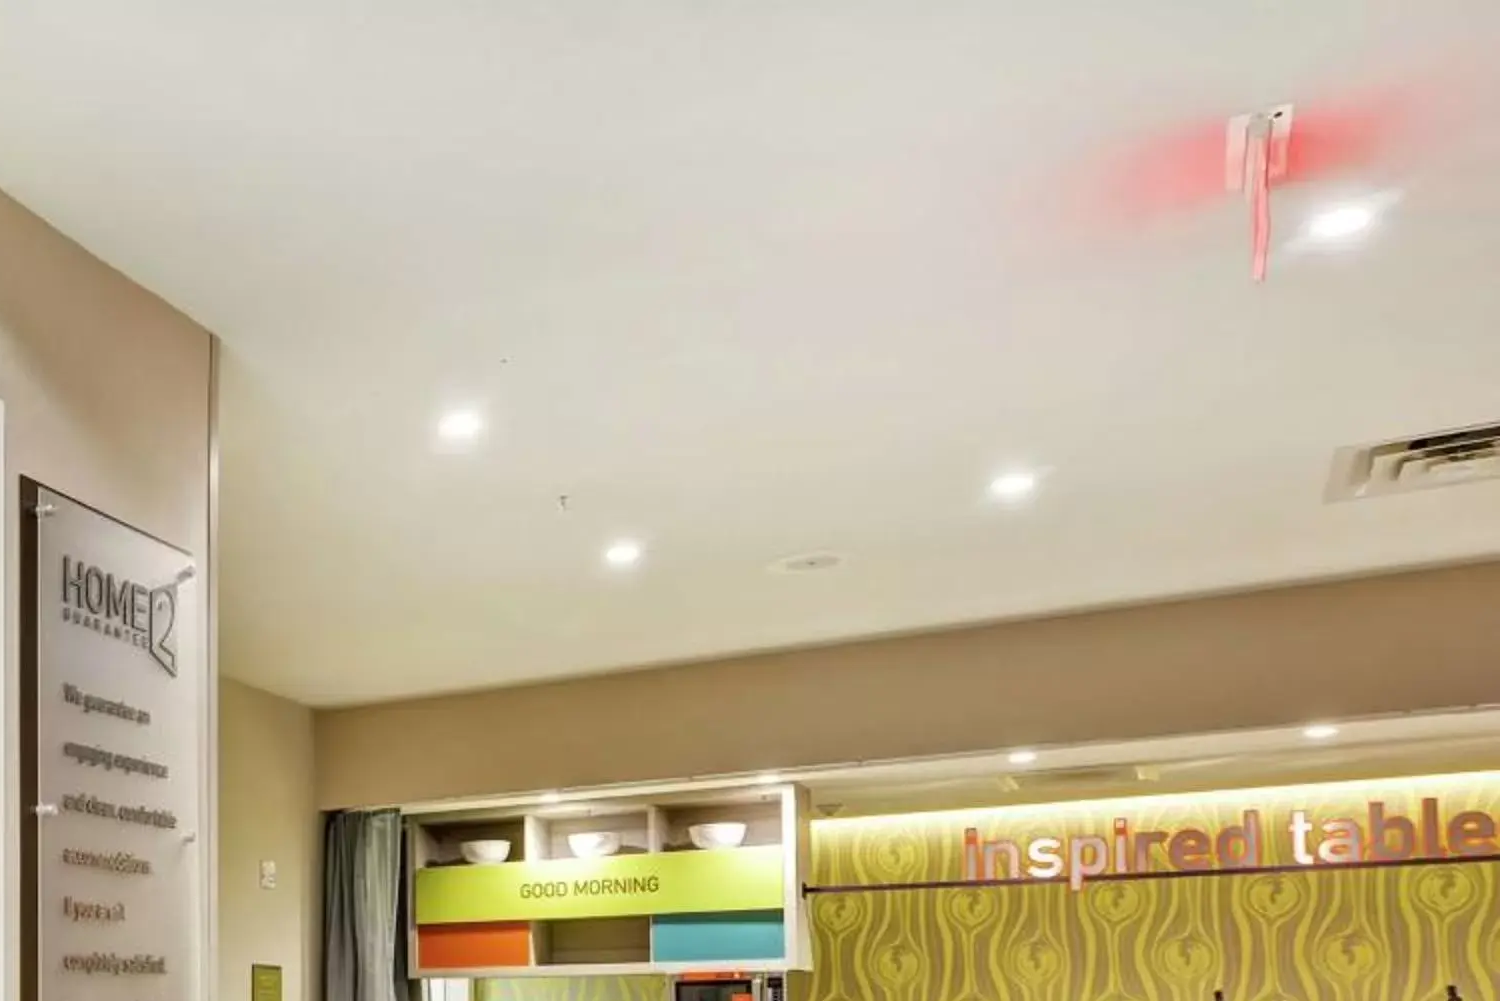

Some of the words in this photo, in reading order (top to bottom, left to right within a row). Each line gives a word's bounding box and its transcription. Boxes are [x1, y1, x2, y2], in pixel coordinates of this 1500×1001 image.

[962, 808, 1262, 892] inspired
[1287, 797, 1499, 866] table
[520, 882, 568, 899] GOOD
[573, 875, 660, 896] MORNING
